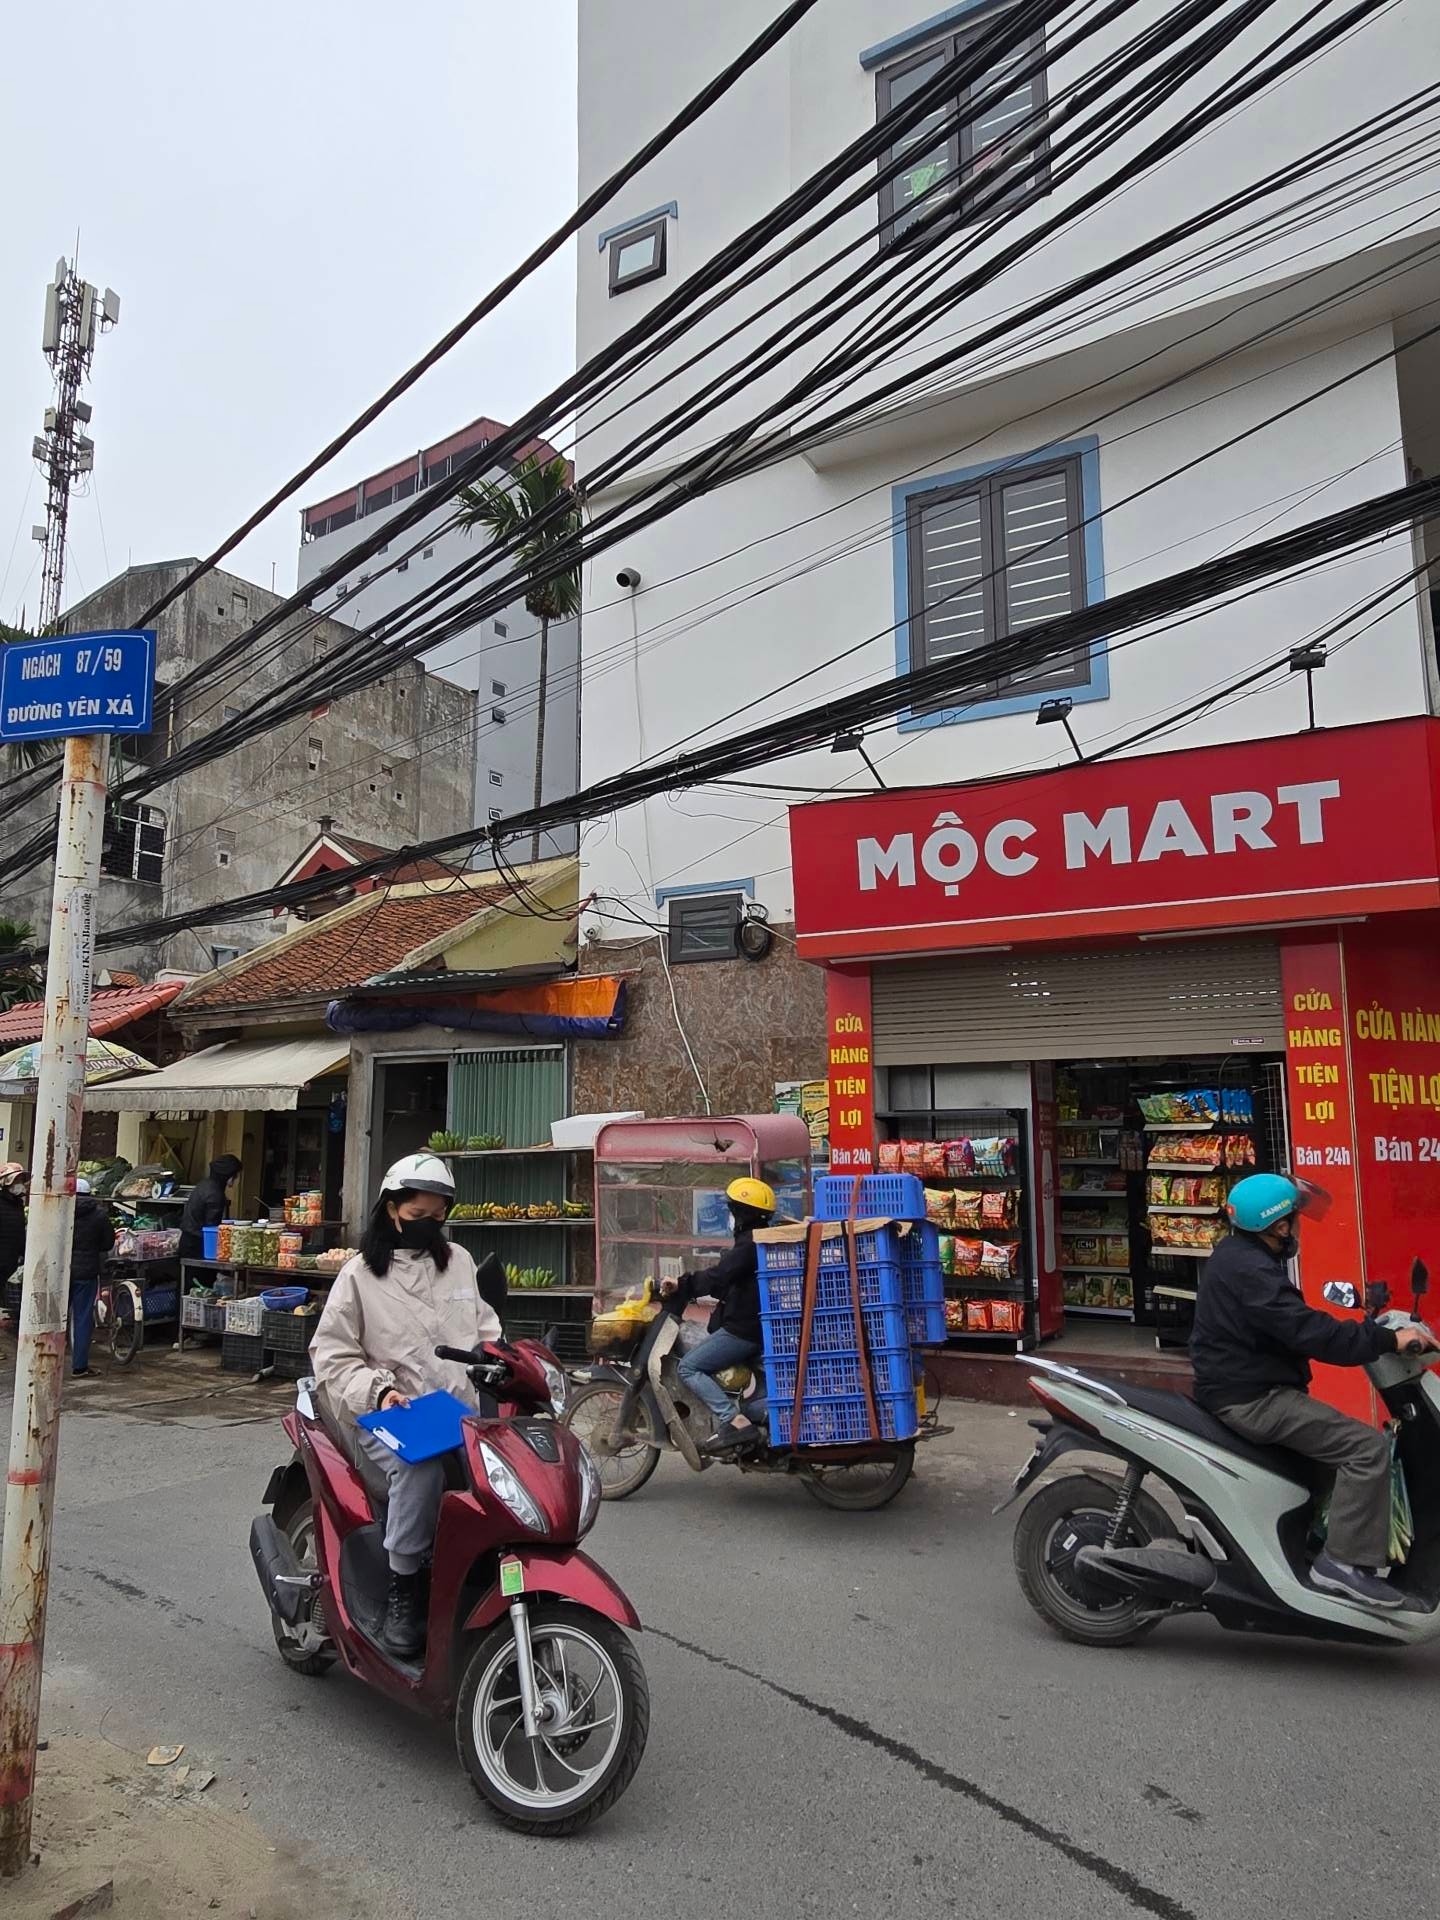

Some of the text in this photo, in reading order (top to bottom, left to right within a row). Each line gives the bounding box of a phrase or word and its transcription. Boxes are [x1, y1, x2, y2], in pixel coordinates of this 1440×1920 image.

[22, 645, 122, 680] NGÁCH 87/59
[8, 694, 134, 724] ĐƯỜNG YÊN XÁ
[857, 779, 1341, 896] MỘC MART
[1293, 988, 1333, 1012] CỬA
[835, 1013, 864, 1033] CỬA
[1355, 1001, 1397, 1040] CỬA
[1288, 1026, 1342, 1048] HÀNG
[831, 1046, 869, 1064] HÀNG
[1295, 1062, 1339, 1087] TIỆN
[835, 1076, 866, 1098] TIỆN
[1369, 1067, 1415, 1110] TIỆN
[840, 1109, 861, 1129] LỢI
[1305, 1101, 1335, 1124] LỢI
[832, 1148, 851, 1164] Bán
[853, 1148, 871, 1165] 24h
[1296, 1146, 1350, 1166] Bán 24h
[1374, 1136, 1412, 1161] Bán
